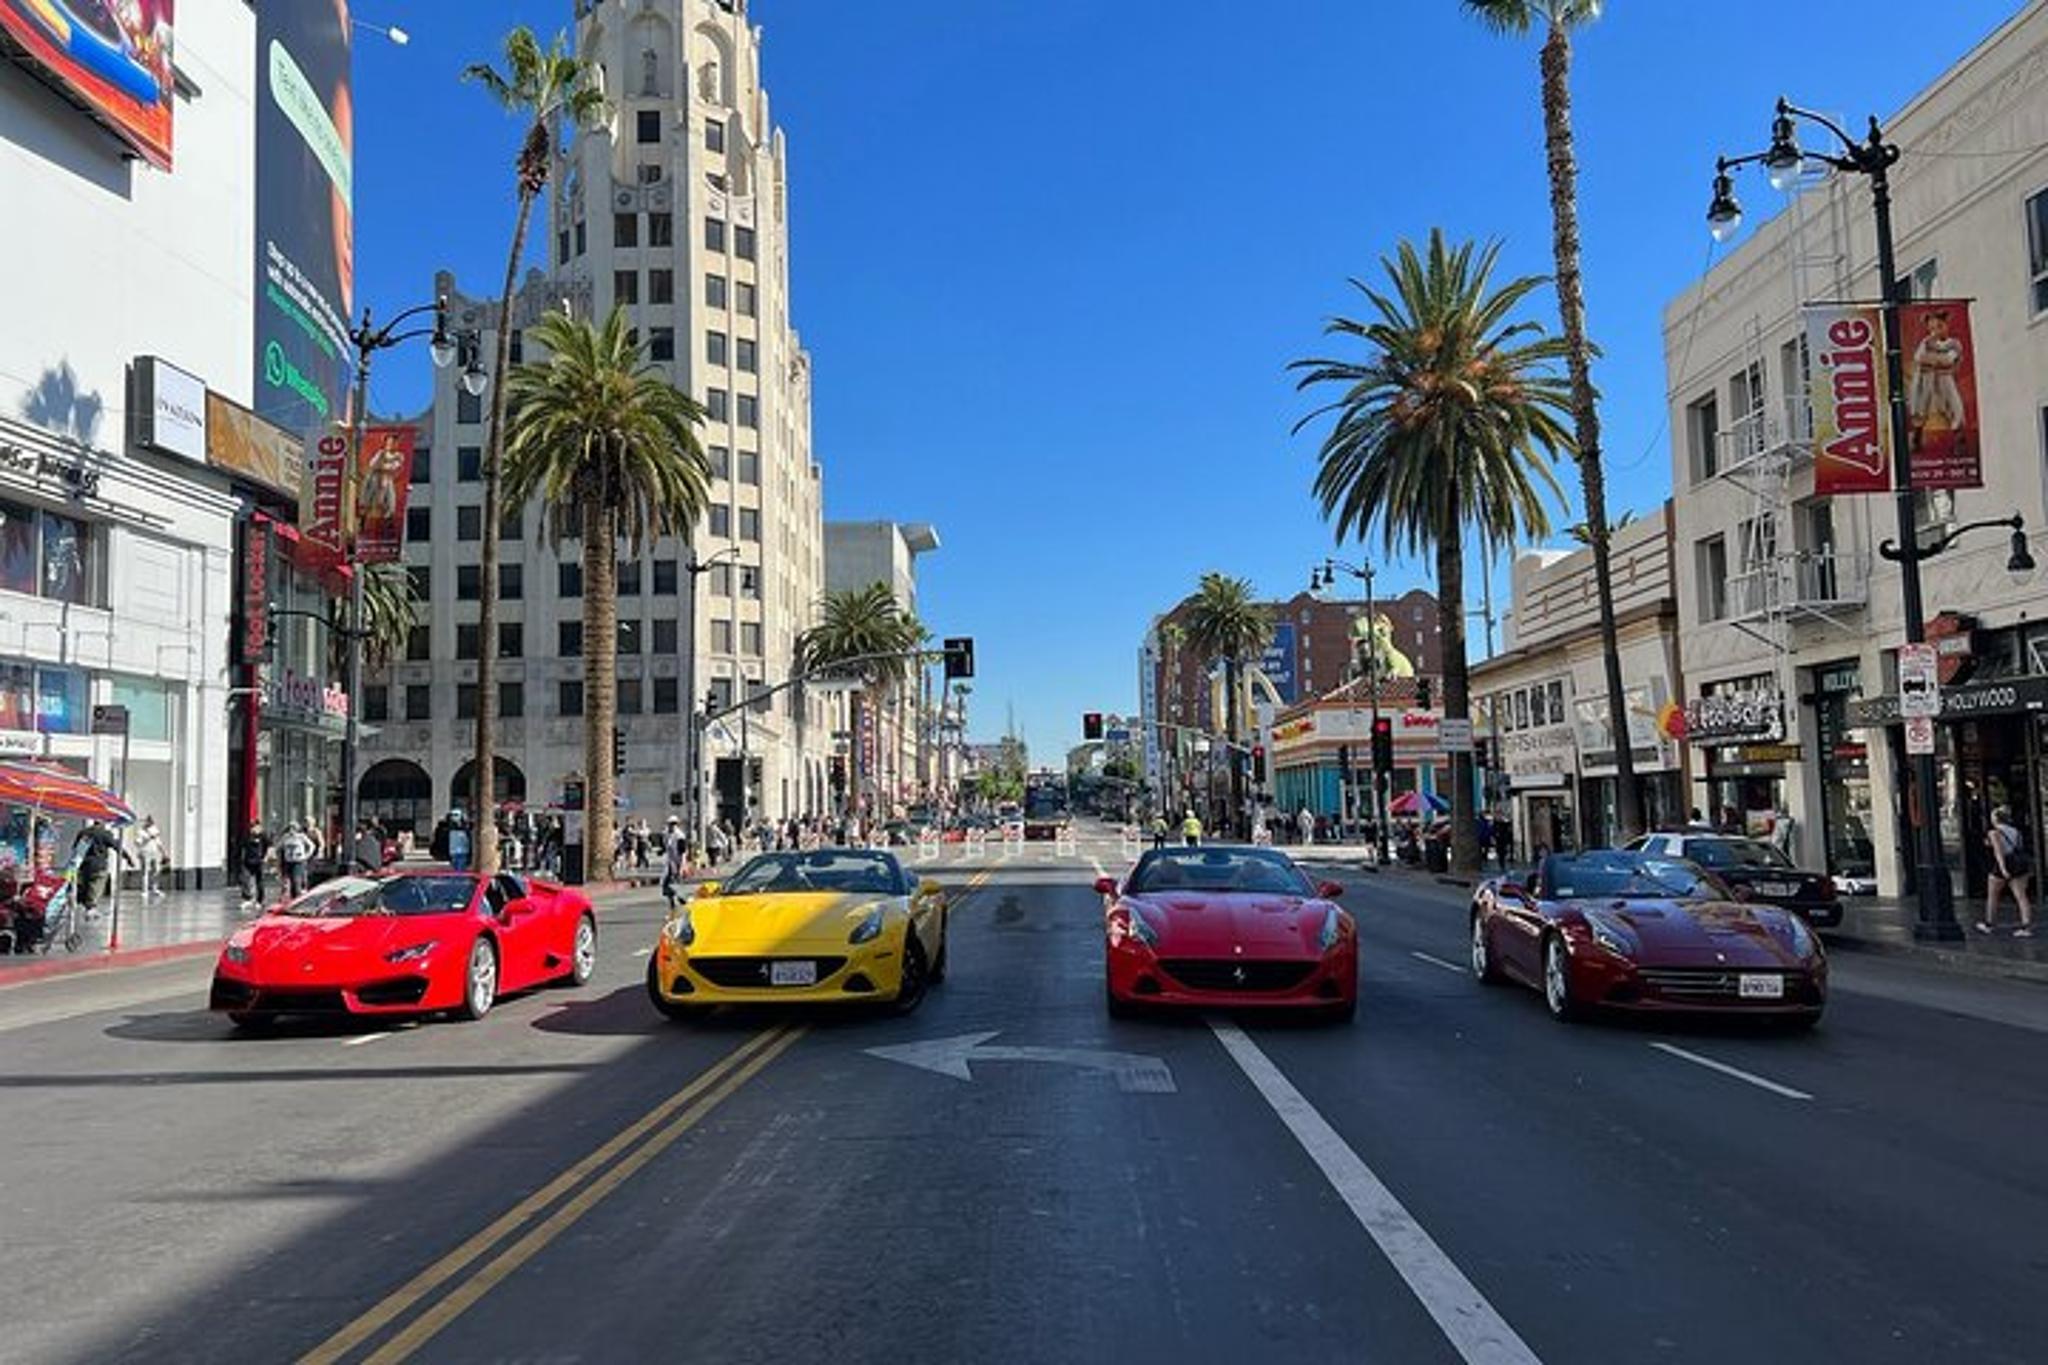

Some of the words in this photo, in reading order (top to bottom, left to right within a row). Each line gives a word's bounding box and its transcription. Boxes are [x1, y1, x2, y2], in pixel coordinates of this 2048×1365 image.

[1824, 318, 1883, 476] Annie
[306, 436, 347, 553] Annie
[1947, 687, 2016, 711] HOLLYWOOD
